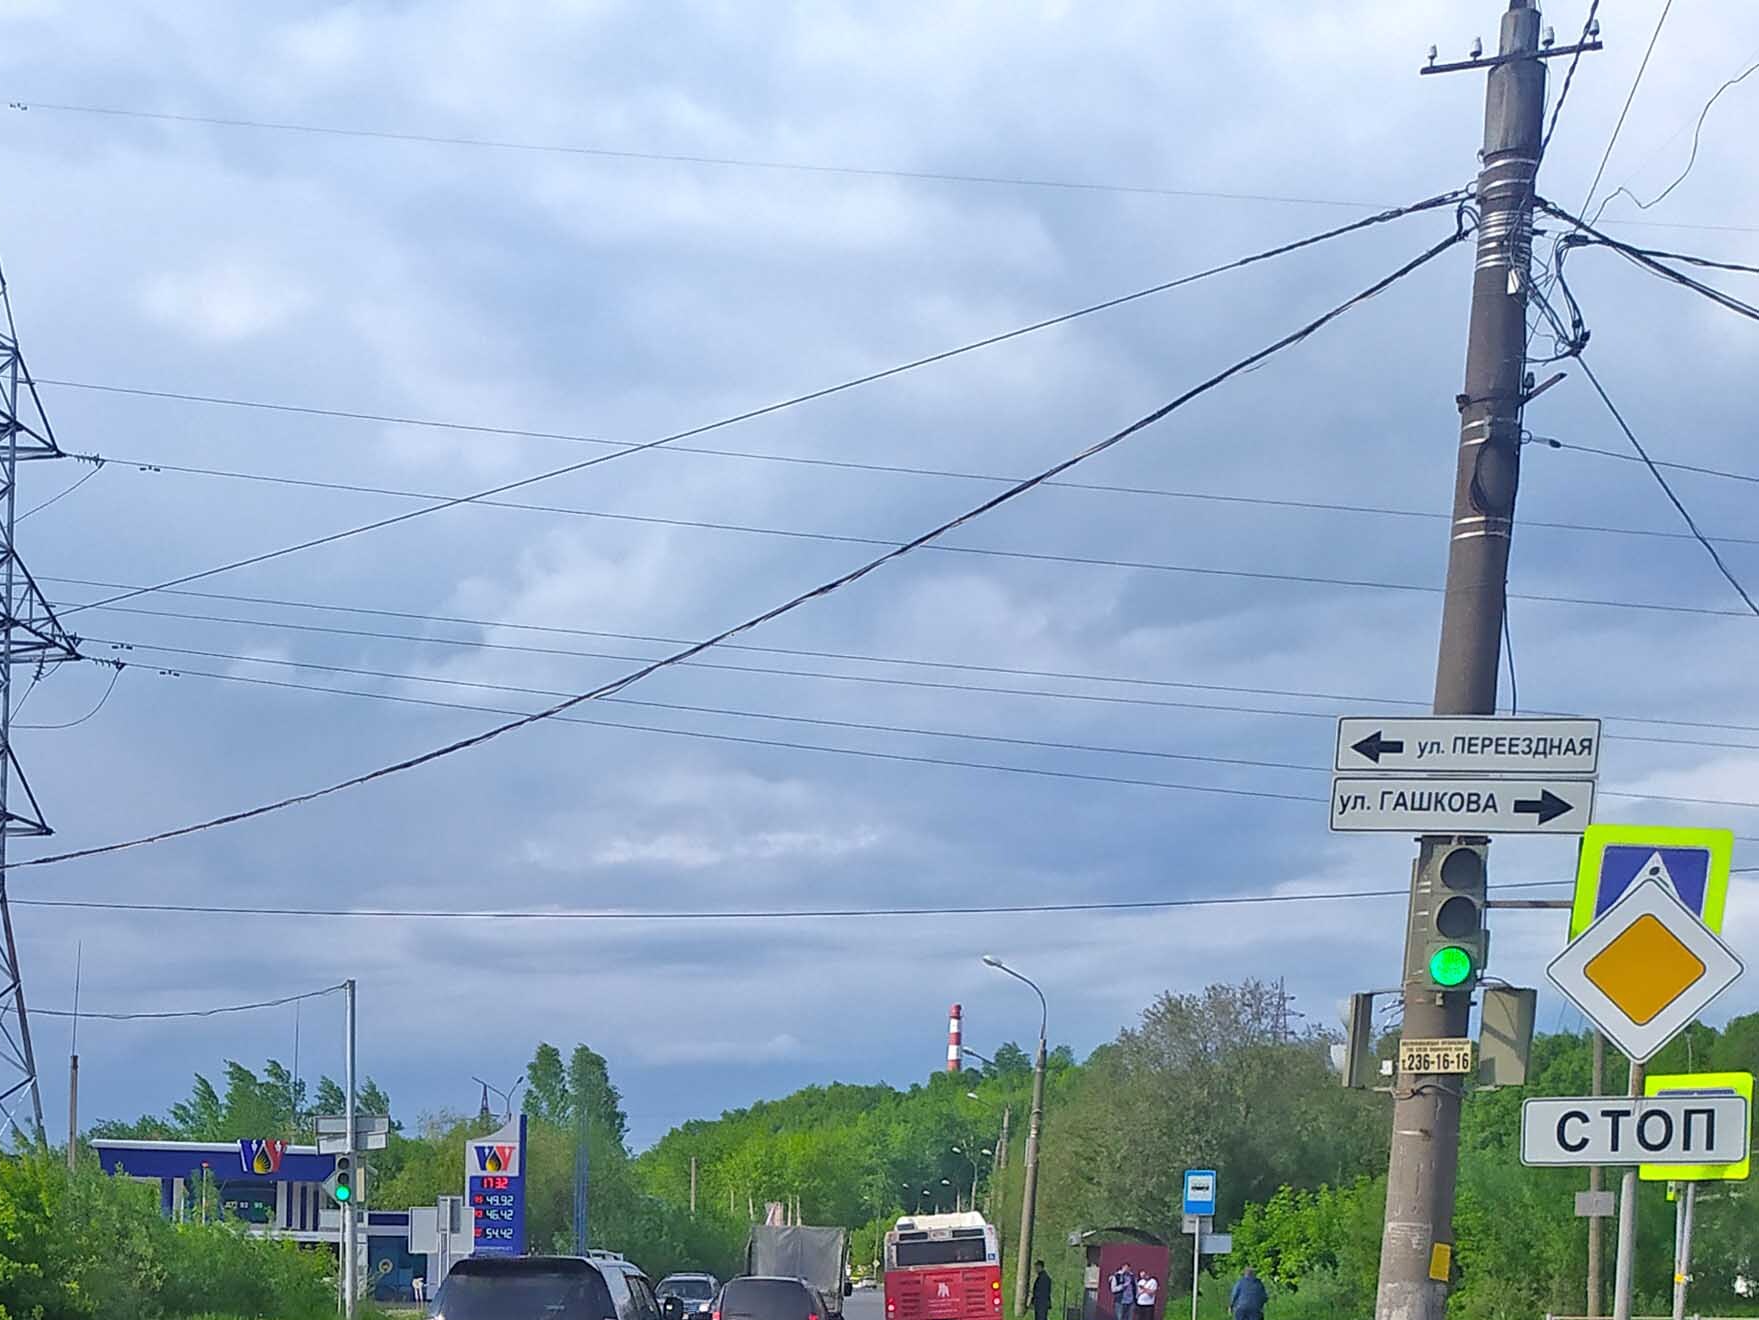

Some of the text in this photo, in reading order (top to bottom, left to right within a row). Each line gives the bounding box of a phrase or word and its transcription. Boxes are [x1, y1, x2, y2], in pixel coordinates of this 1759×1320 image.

[1417, 736, 1593, 760] ул. ПЕРЕЕЗДНАЯ
[1338, 790, 1498, 815] ул. ГАШКОВА
[1555, 1108, 1716, 1153] СТОП
